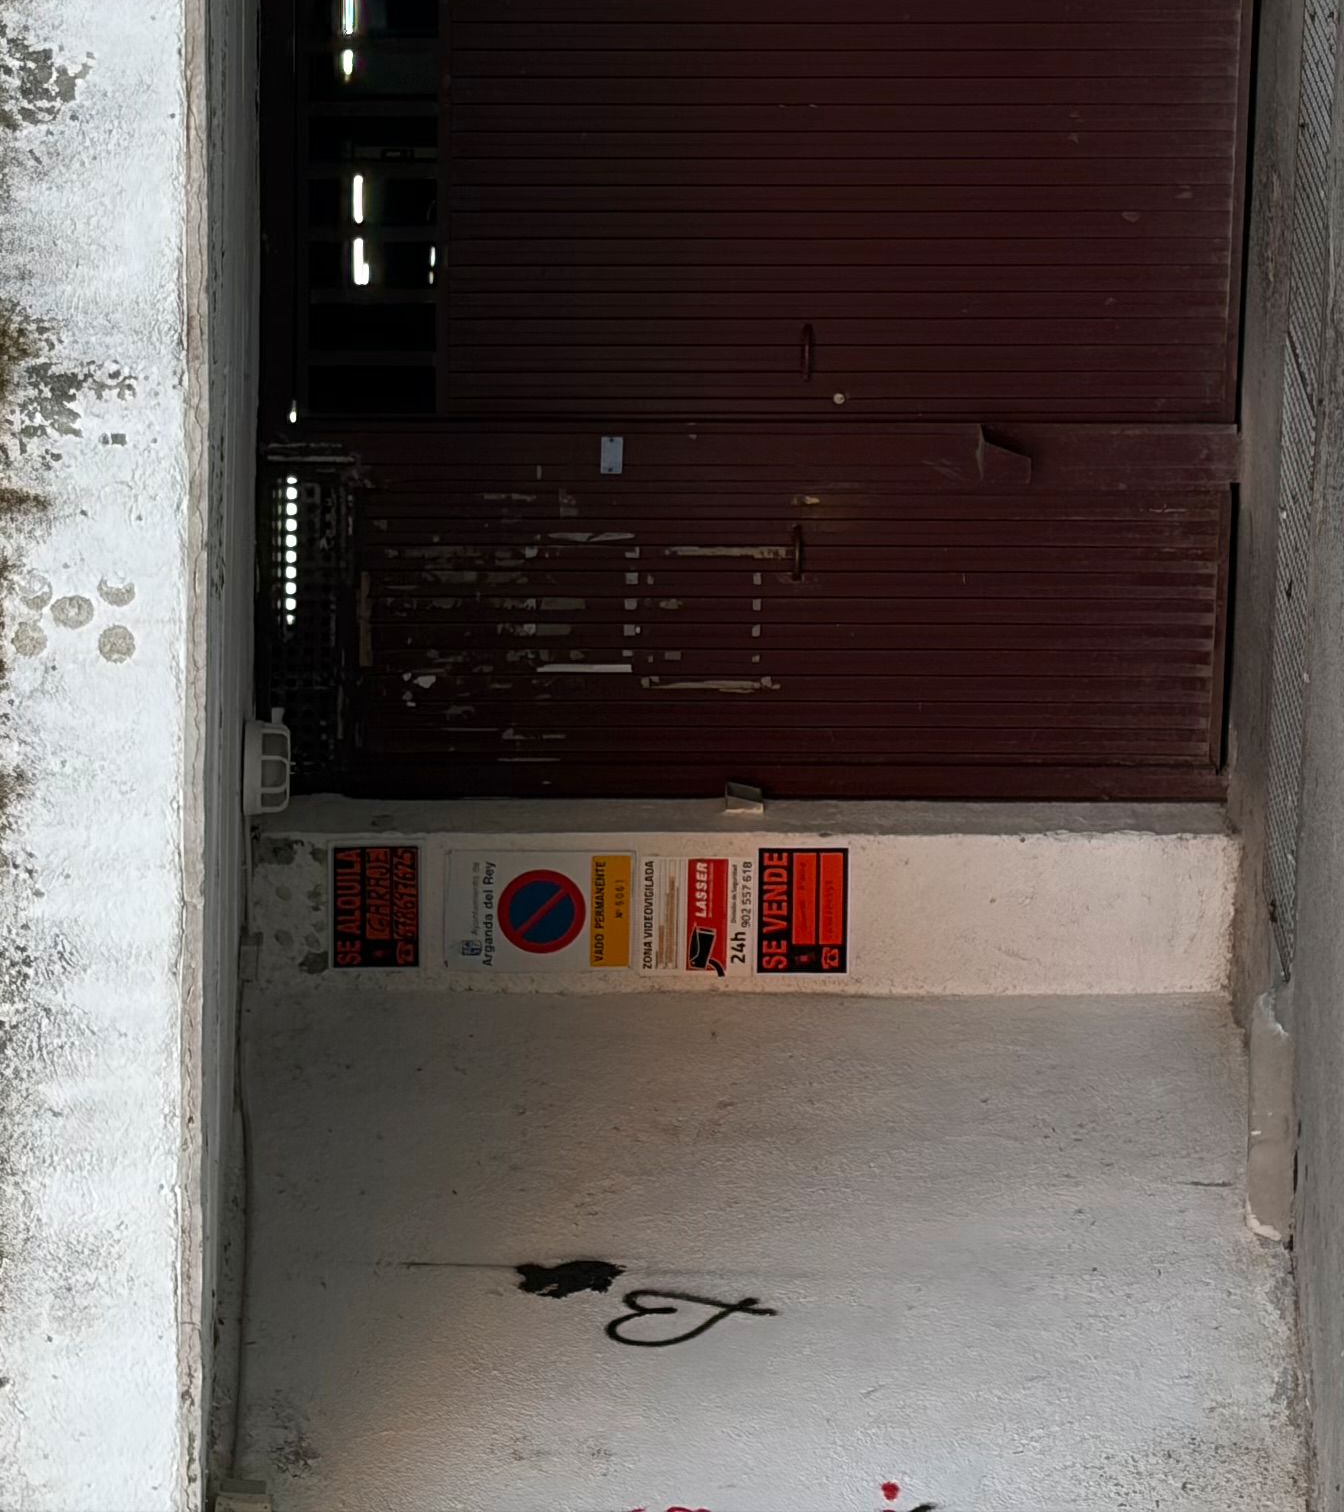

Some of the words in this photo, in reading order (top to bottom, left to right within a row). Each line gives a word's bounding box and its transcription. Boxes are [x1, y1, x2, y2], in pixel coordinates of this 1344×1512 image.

[483, 861, 496, 885] Rey
[742, 861, 752, 882] 618
[337, 849, 361, 934] ALQUILA
[365, 850, 389, 932] GARAJE
[483, 890, 493, 909] del
[595, 861, 606, 929] PERMANENTE
[643, 860, 654, 939] VIDEOVIGILADA
[694, 862, 708, 918] LASSER
[741, 884, 752, 905] 557
[762, 852, 788, 934] VENDE
[741, 908, 751, 928] 902
[337, 940, 362, 965] SE
[482, 914, 495, 967] Arganda
[594, 934, 604, 962] VADO
[730, 932, 747, 964] 24h
[762, 940, 788, 969] SE
[643, 941, 652, 970] ZONA
